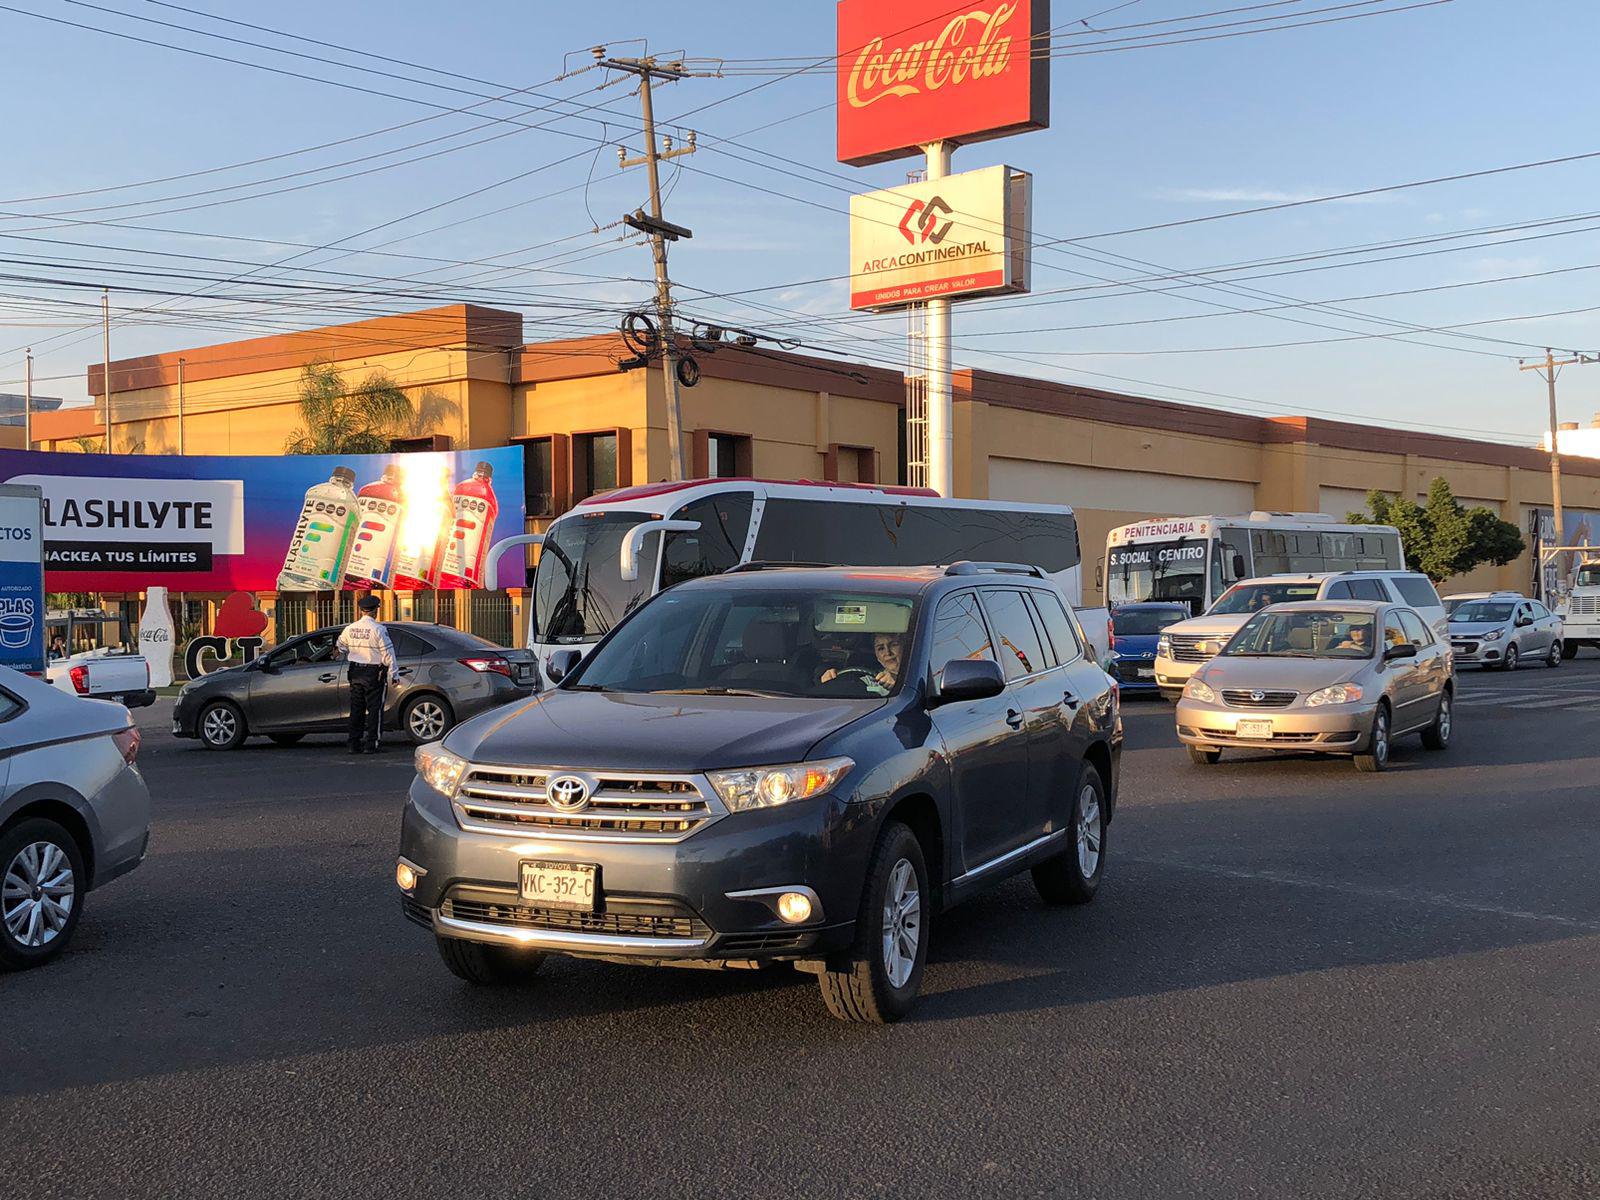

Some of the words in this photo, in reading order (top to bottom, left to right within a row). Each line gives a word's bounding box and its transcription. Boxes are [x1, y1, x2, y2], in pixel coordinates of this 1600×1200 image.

[847, 0, 1020, 107] Coca-Cola
[862, 240, 991, 273] ARCACONTINENTAL
[875, 289, 901, 300] UNIDOS
[903, 286, 922, 296] PARA
[925, 282, 949, 293] CREAR
[951, 278, 976, 289] VALOR
[43, 498, 213, 529] LASHLYTE
[284, 500, 315, 571] FLASHLYTE
[1124, 522, 1194, 538] PENITENCIARIA
[106, 551, 135, 562] TUS
[139, 549, 197, 563] LÍMITES
[1120, 551, 1151, 564] SOCIAL
[1158, 546, 1204, 561] CENTRO
[523, 874, 592, 897] VKC-352-C
